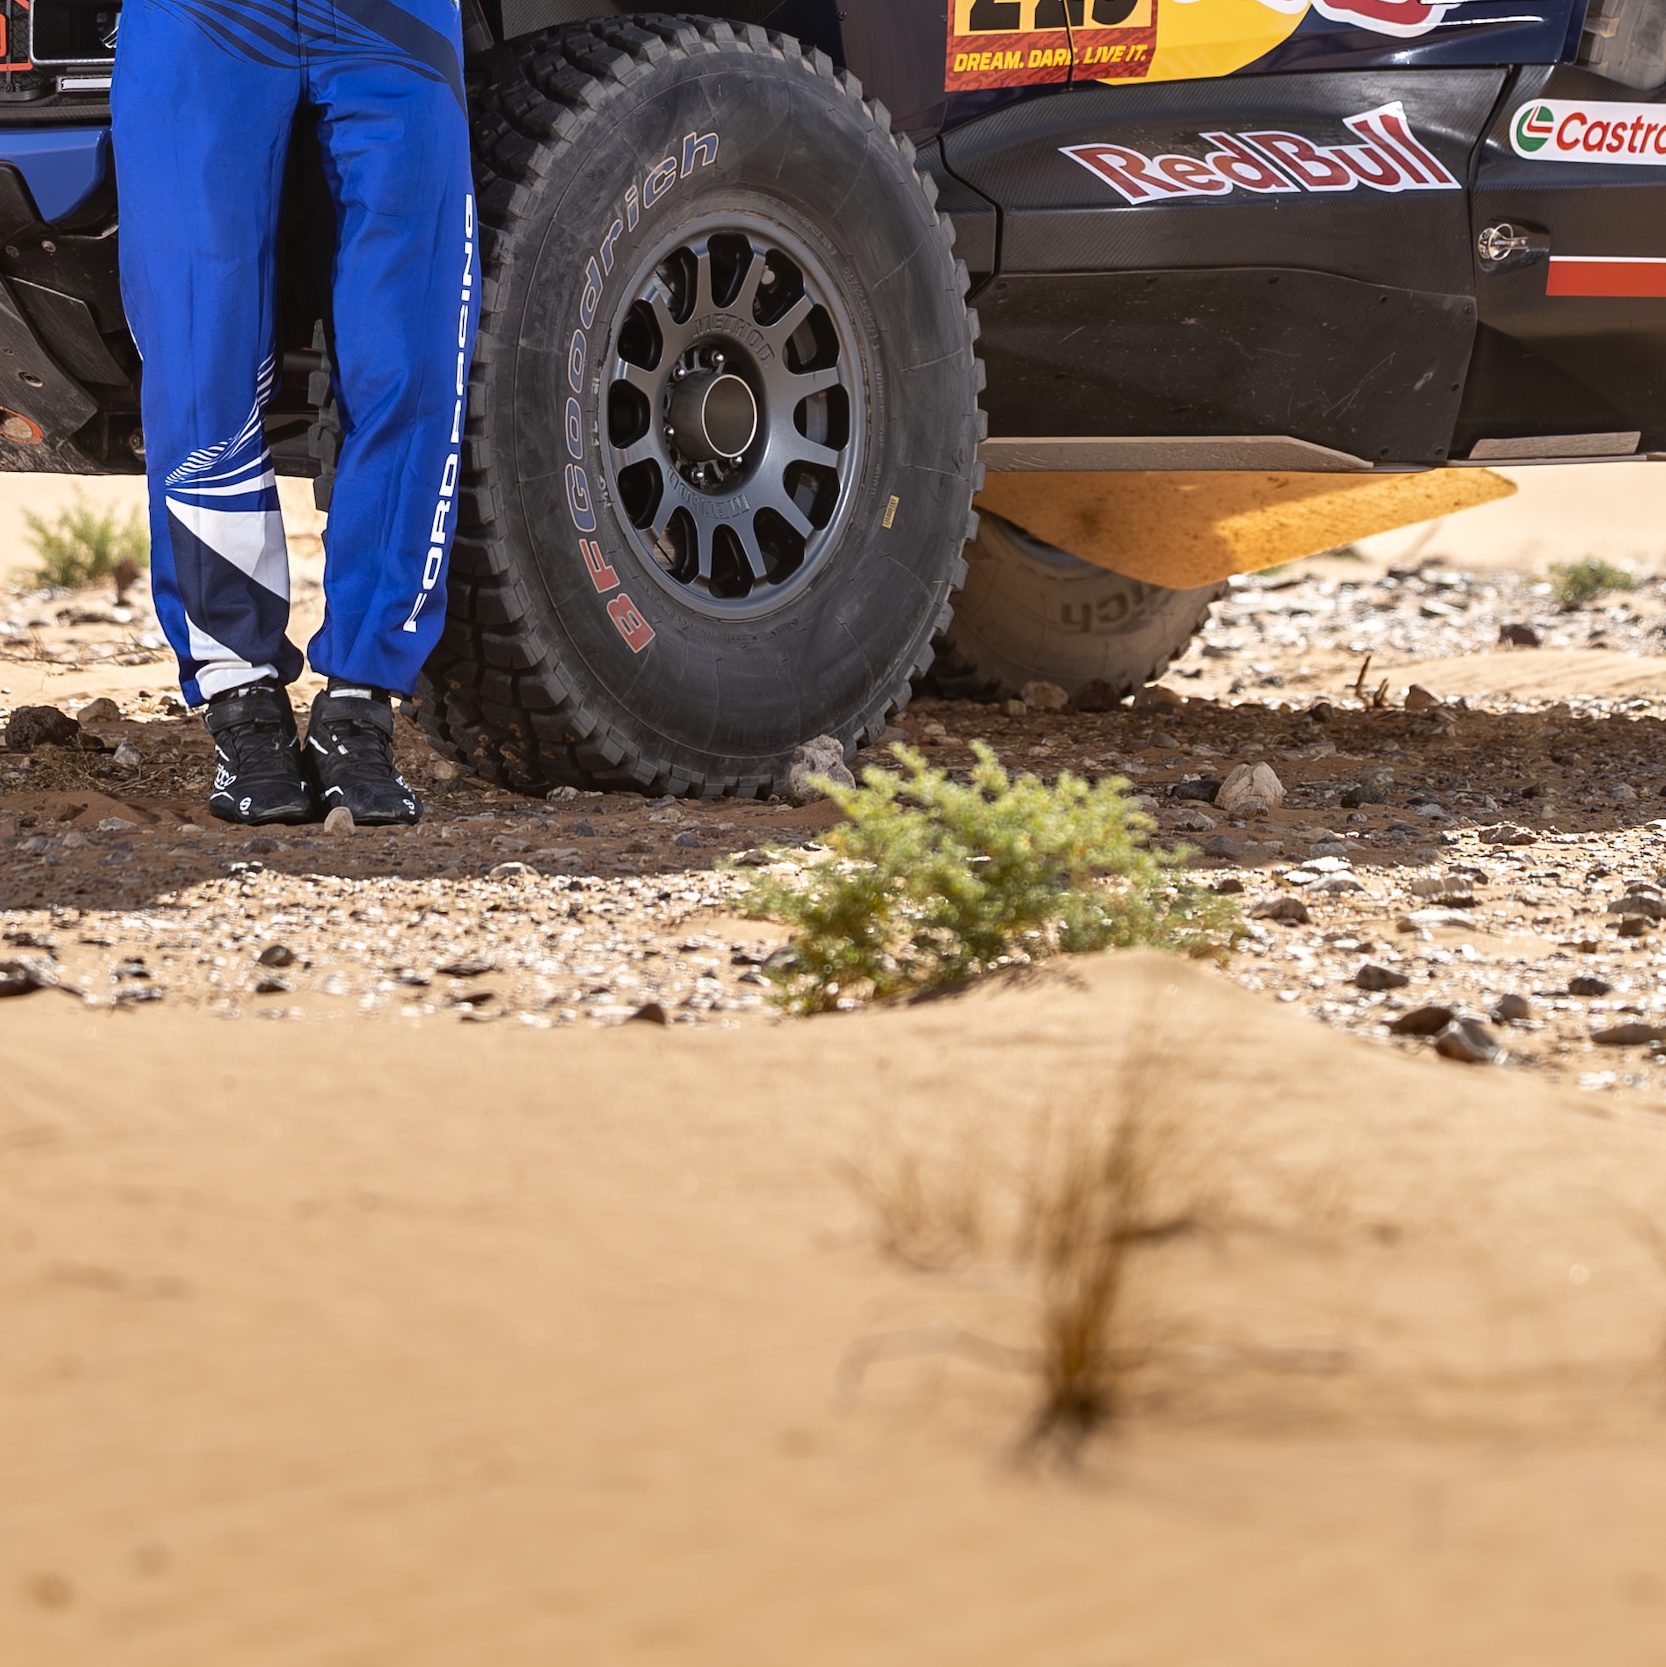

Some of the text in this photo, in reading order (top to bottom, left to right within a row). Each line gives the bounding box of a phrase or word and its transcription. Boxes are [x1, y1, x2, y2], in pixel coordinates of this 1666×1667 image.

[953, 51, 1024, 72] DREAM.
[1084, 45, 1126, 64] LIVE
[1125, 44, 1148, 62] IT.
[1059, 101, 1461, 206] Red Bull
[564, 131, 721, 654] BFGoodrich
[693, 313, 775, 367] METHOD
[402, 453, 459, 633] FORD
